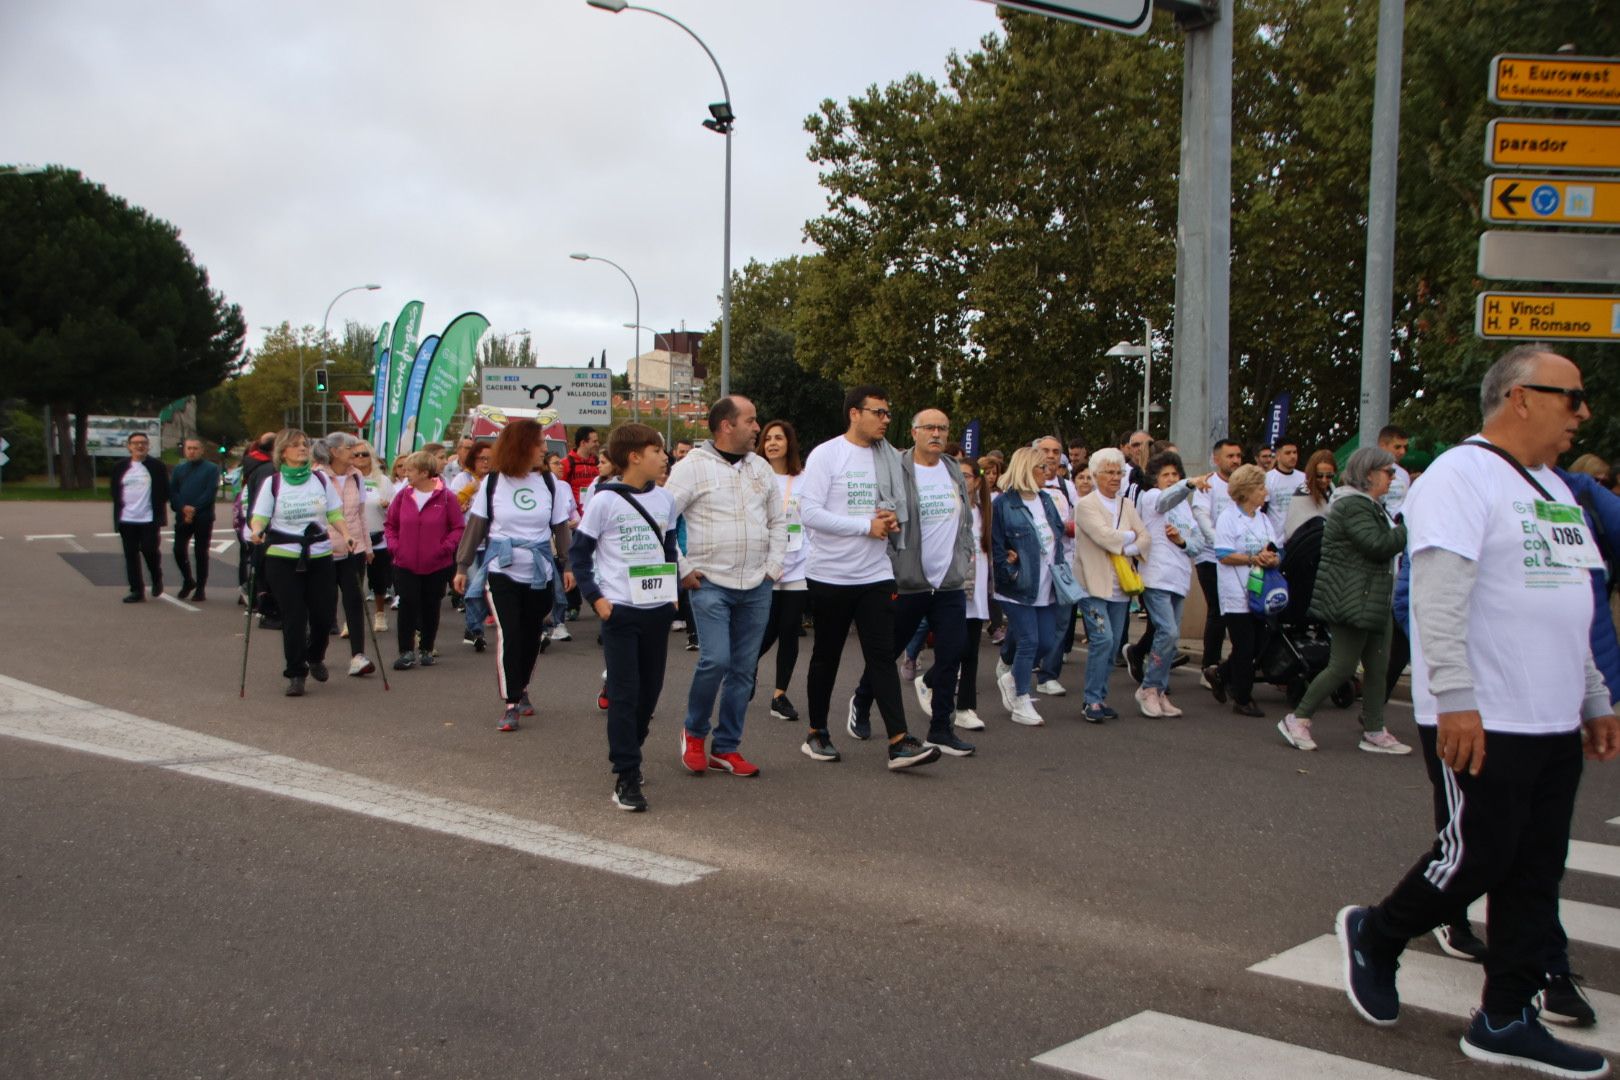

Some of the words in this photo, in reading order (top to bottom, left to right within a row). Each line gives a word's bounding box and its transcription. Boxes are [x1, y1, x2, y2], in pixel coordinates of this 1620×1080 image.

[1501, 64, 1518, 79] H.
[1529, 65, 1609, 82] Eurowest
[1499, 139, 1567, 153] parador
[1489, 300, 1502, 314] H.
[1511, 301, 1555, 315] Vincci
[1488, 317, 1502, 330] H.
[1509, 318, 1522, 330] P.
[1530, 318, 1591, 332] Romano
[920, 501, 944, 509] contra
[620, 525, 632, 534] En
[620, 534, 650, 542] contra
[621, 543, 629, 551] el
[1523, 553, 1540, 567] el
[641, 577, 663, 590] 8877
